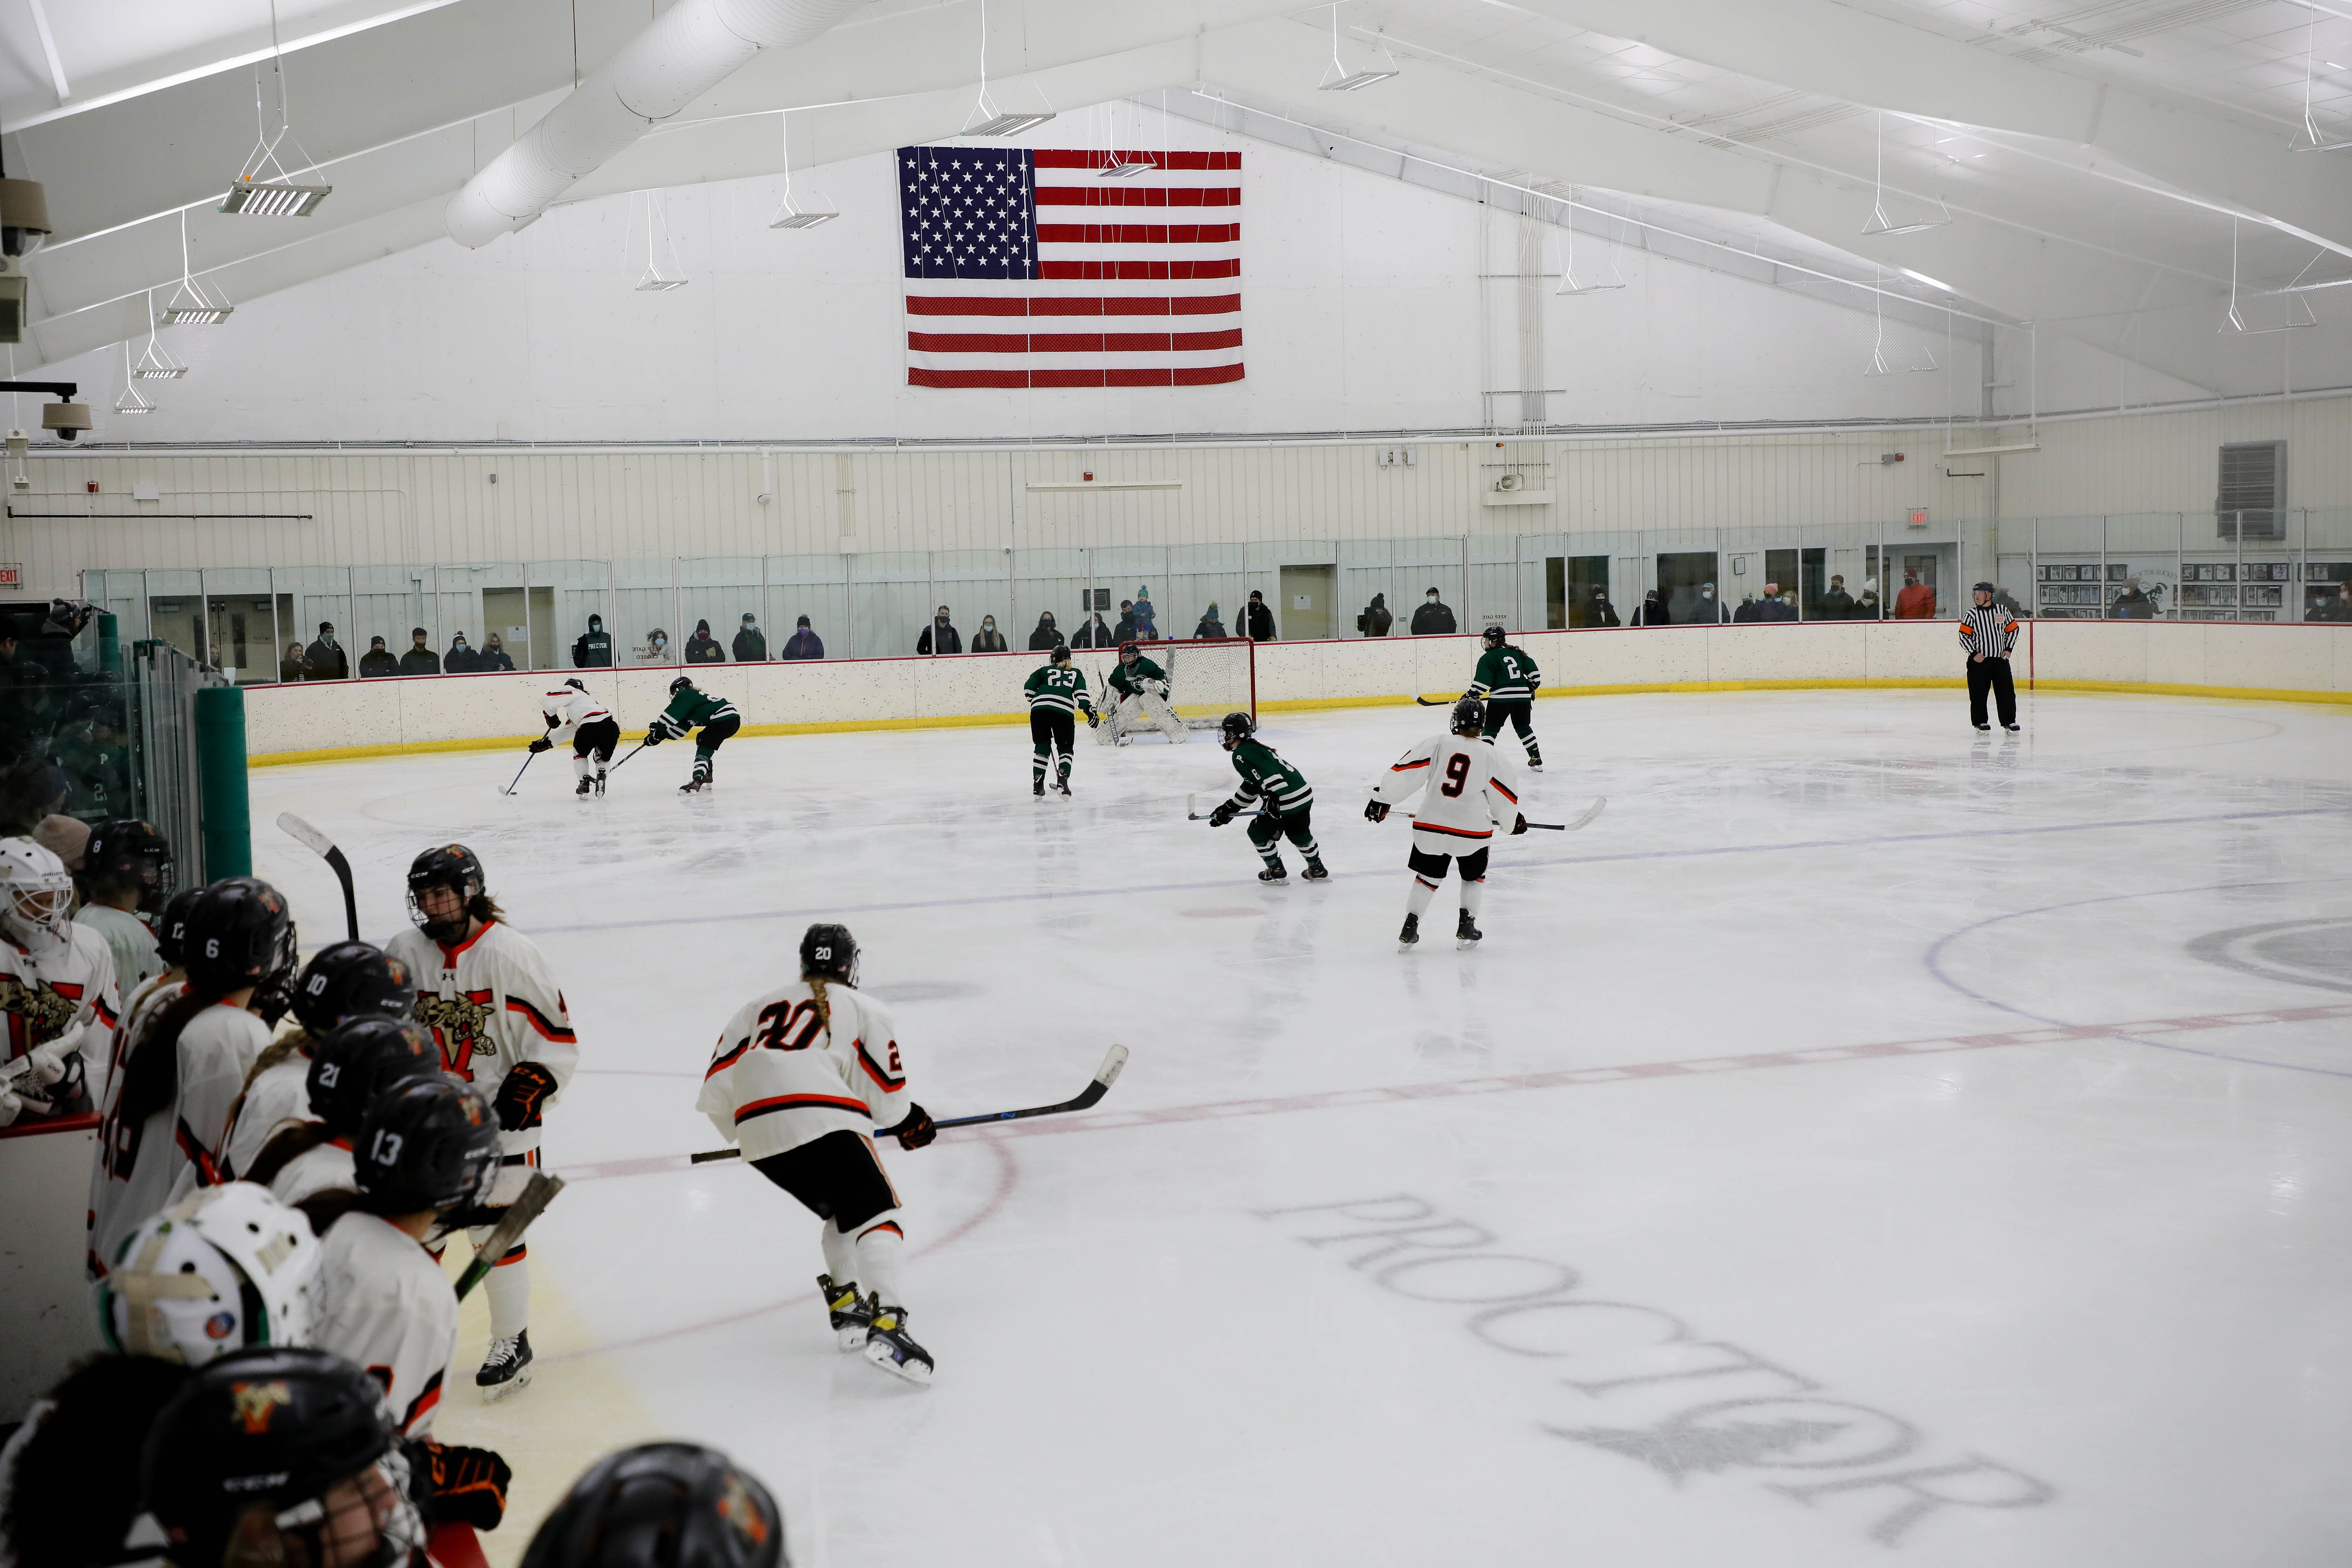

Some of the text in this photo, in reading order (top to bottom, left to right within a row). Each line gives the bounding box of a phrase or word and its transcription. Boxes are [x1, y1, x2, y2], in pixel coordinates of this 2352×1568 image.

[1913, 513, 1925, 523] EXIT
[0, 570, 17, 582] EXIT
[2156, 569, 2178, 580] HOCKEY
[1503, 656, 1521, 679] 2
[1047, 669, 1077, 688] 23
[1166, 709, 1181, 723] CCM
[1108, 715, 1119, 742] BAUER
[1236, 755, 1244, 763] P
[1251, 768, 1261, 781] 8
[1441, 753, 1471, 798] 9
[93, 840, 101, 853] 8
[462, 865, 475, 874] CCM
[206, 939, 219, 959] 6
[815, 946, 832, 960] 20
[306, 973, 328, 996] 10
[750, 1000, 831, 1051] 20
[318, 1062, 341, 1089] 21
[370, 1129, 403, 1167] 13
[1246, 1191, 2060, 1549] PROCTOR
